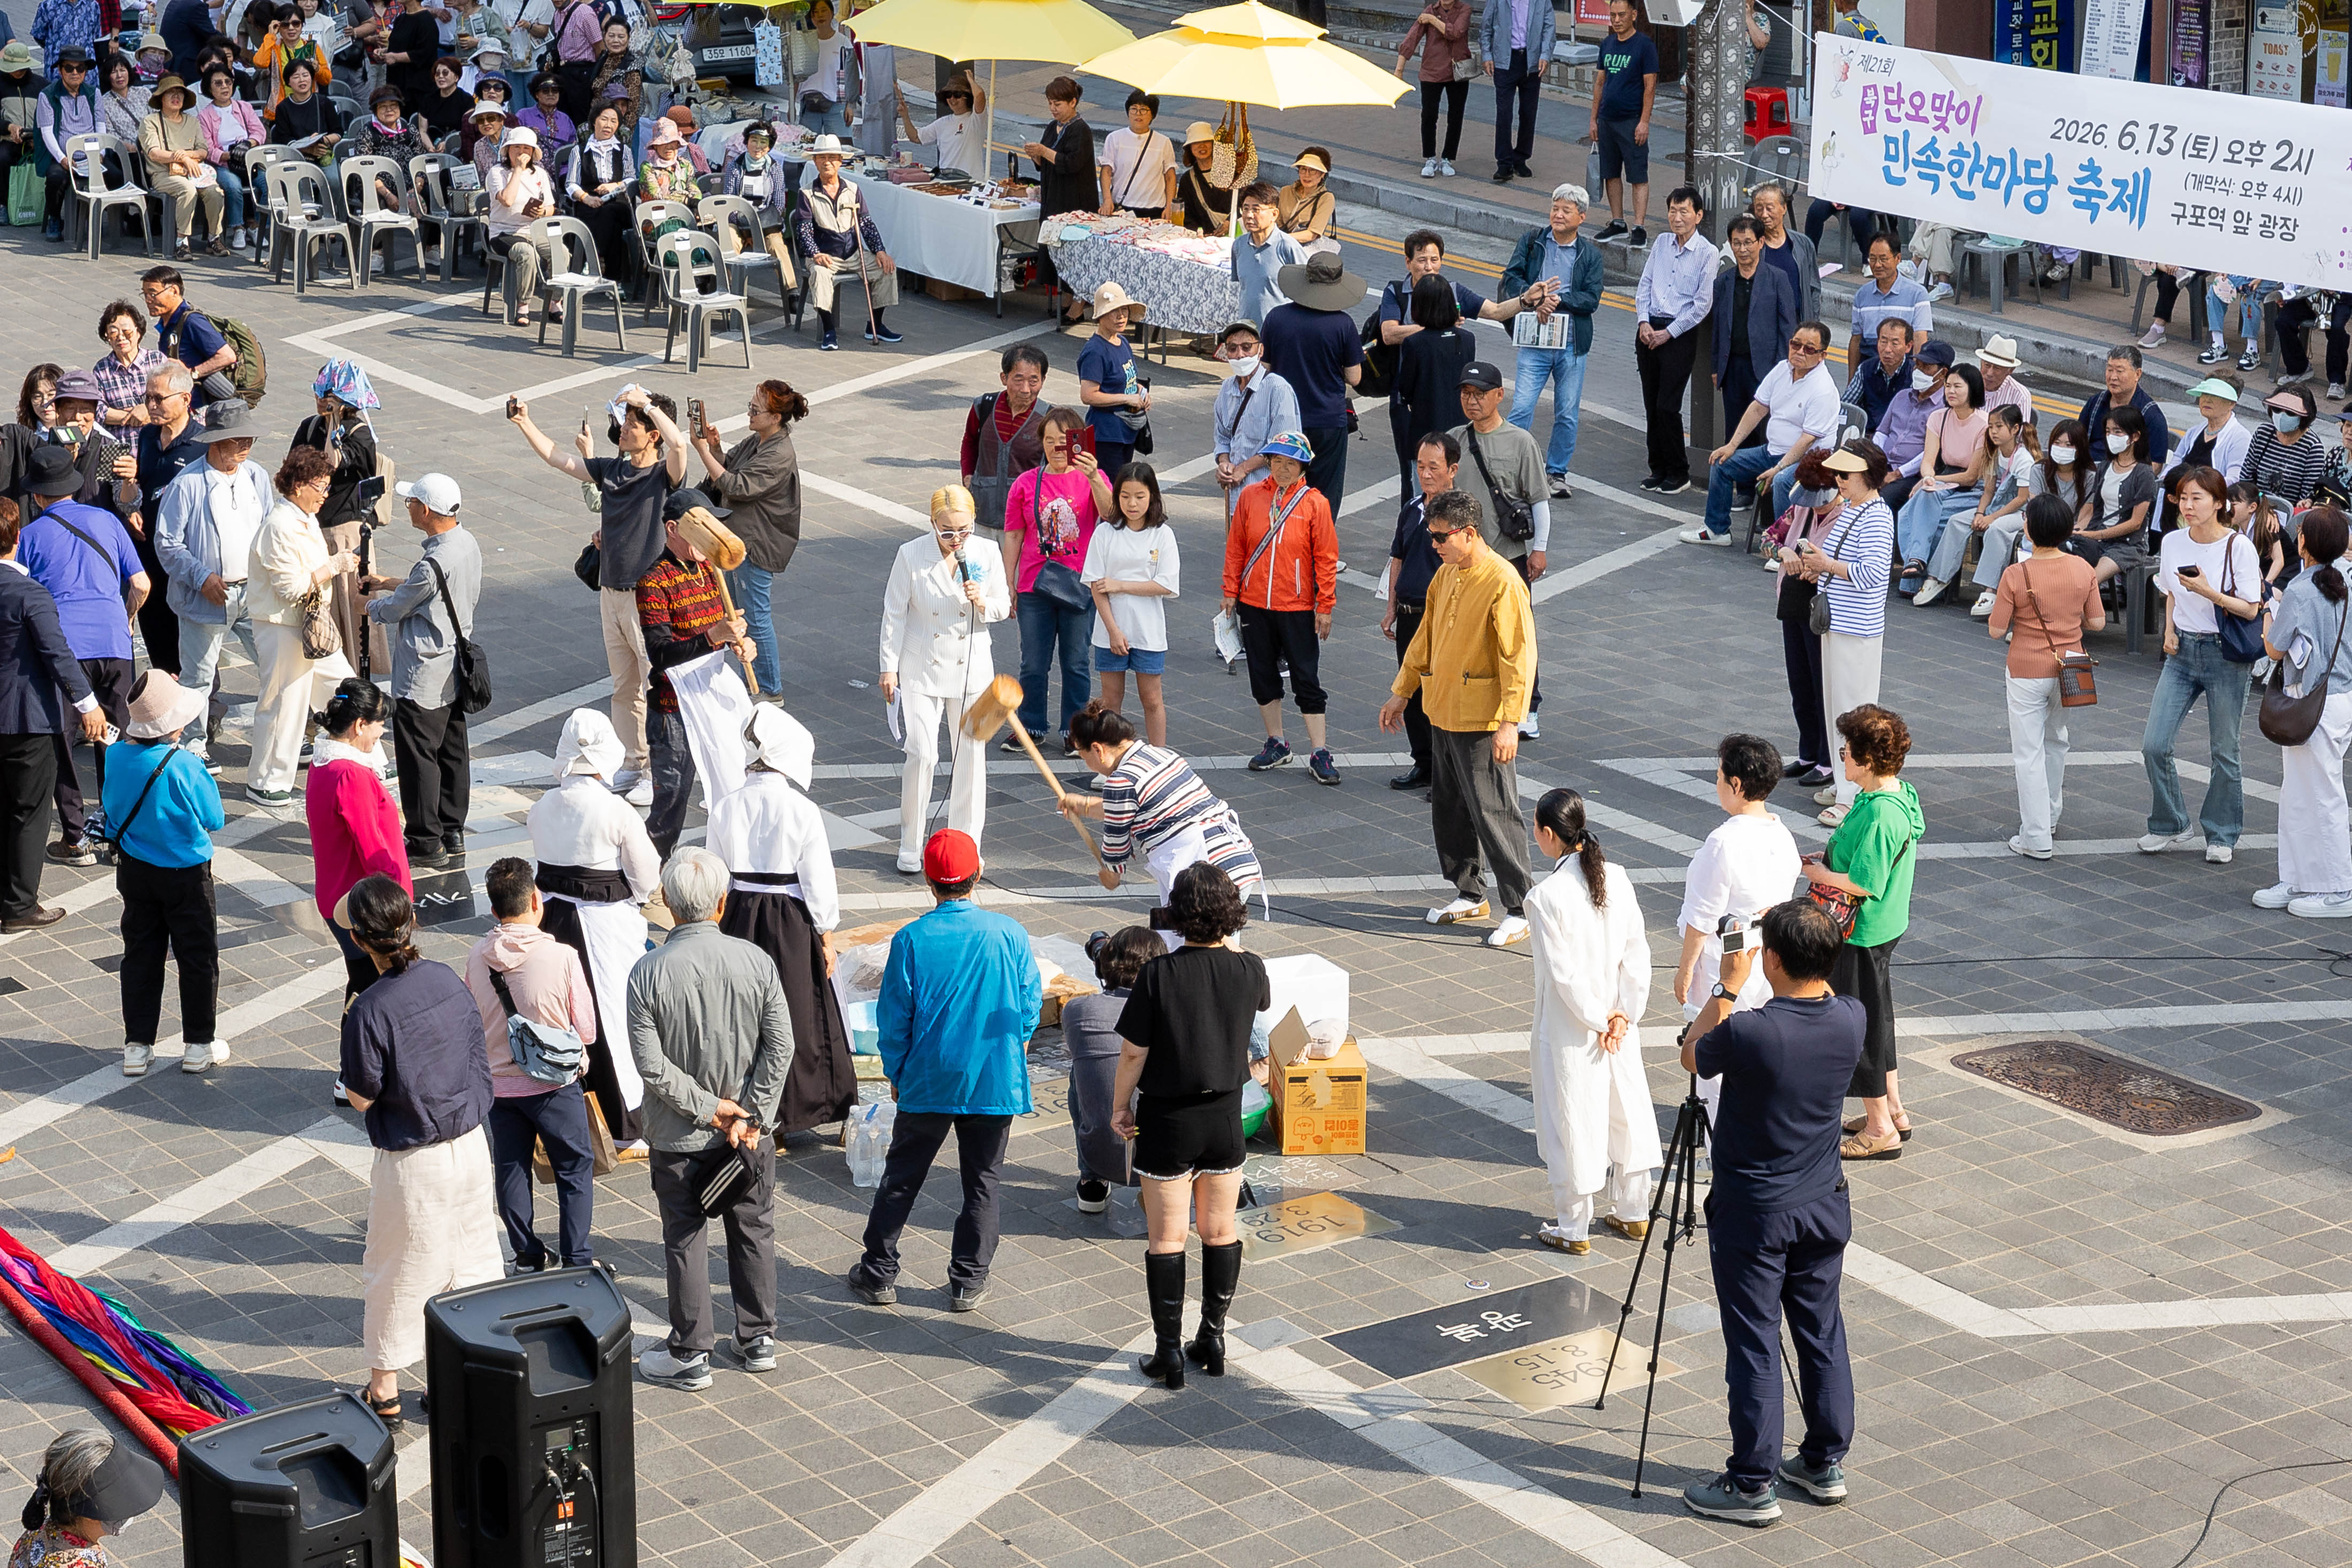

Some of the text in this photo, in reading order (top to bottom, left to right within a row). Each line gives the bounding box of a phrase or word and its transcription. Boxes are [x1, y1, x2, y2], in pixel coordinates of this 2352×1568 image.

[729, 46, 751, 55] 1160
[1604, 54, 1631, 67] RUN
[2263, 43, 2289, 56] TOAST
[1857, 54, 1896, 77] 제21회
[1863, 81, 1983, 137] 북구 단오맞이
[2117, 120, 2178, 156] 6.13
[2181, 133, 2219, 164] (토)
[2223, 140, 2267, 168] 오후
[2270, 139, 2314, 175] 2시
[1882, 130, 2151, 229] 민속한마당 축제
[2184, 172, 2302, 206] (개막식: 오후 4시)
[2171, 202, 2299, 242] 구포역 앞 광장
[1324, 1119, 1359, 1131] 종이컵
[1435, 1311, 1532, 1342] 광복
